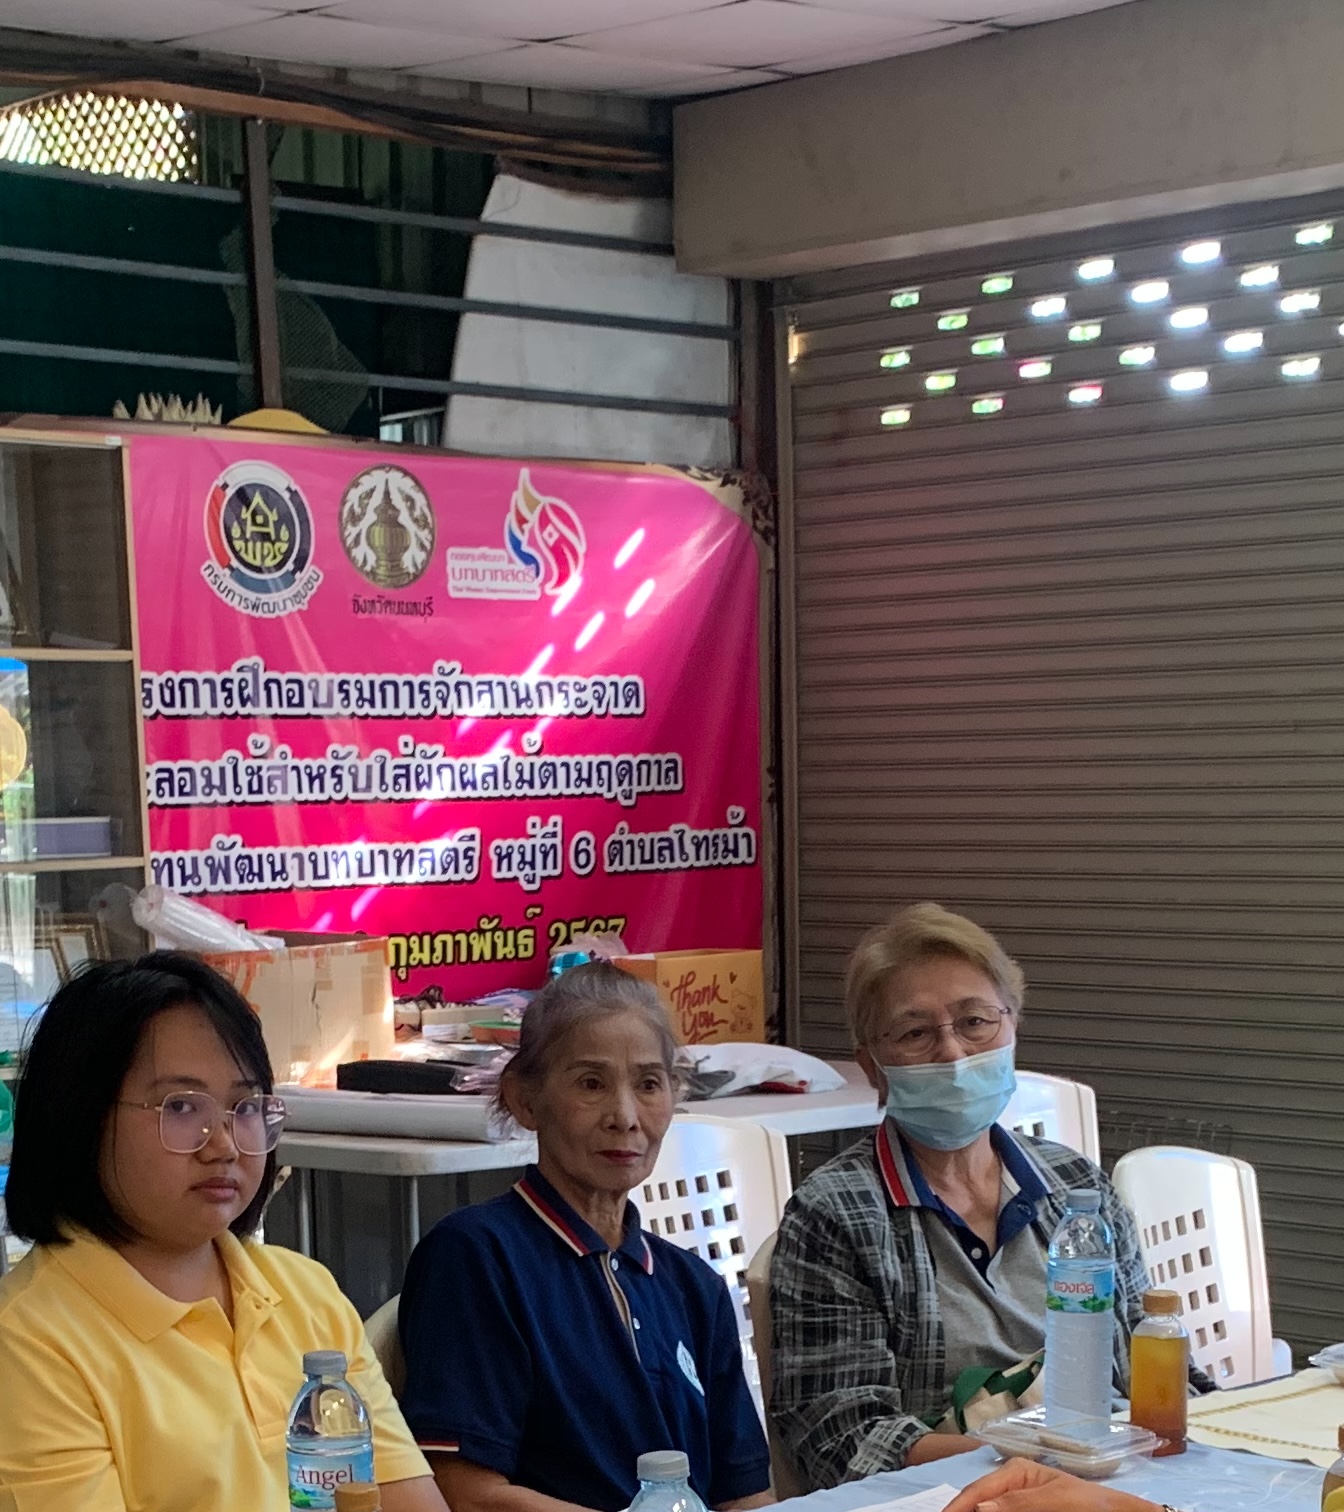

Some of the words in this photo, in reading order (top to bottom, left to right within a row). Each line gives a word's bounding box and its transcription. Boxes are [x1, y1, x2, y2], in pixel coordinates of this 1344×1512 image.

[495, 819, 558, 884] หมู่ที่
[573, 837, 593, 868] 6
[608, 810, 754, 870] ตำบลไทรม้า
[296, 1463, 354, 1490] Angel
